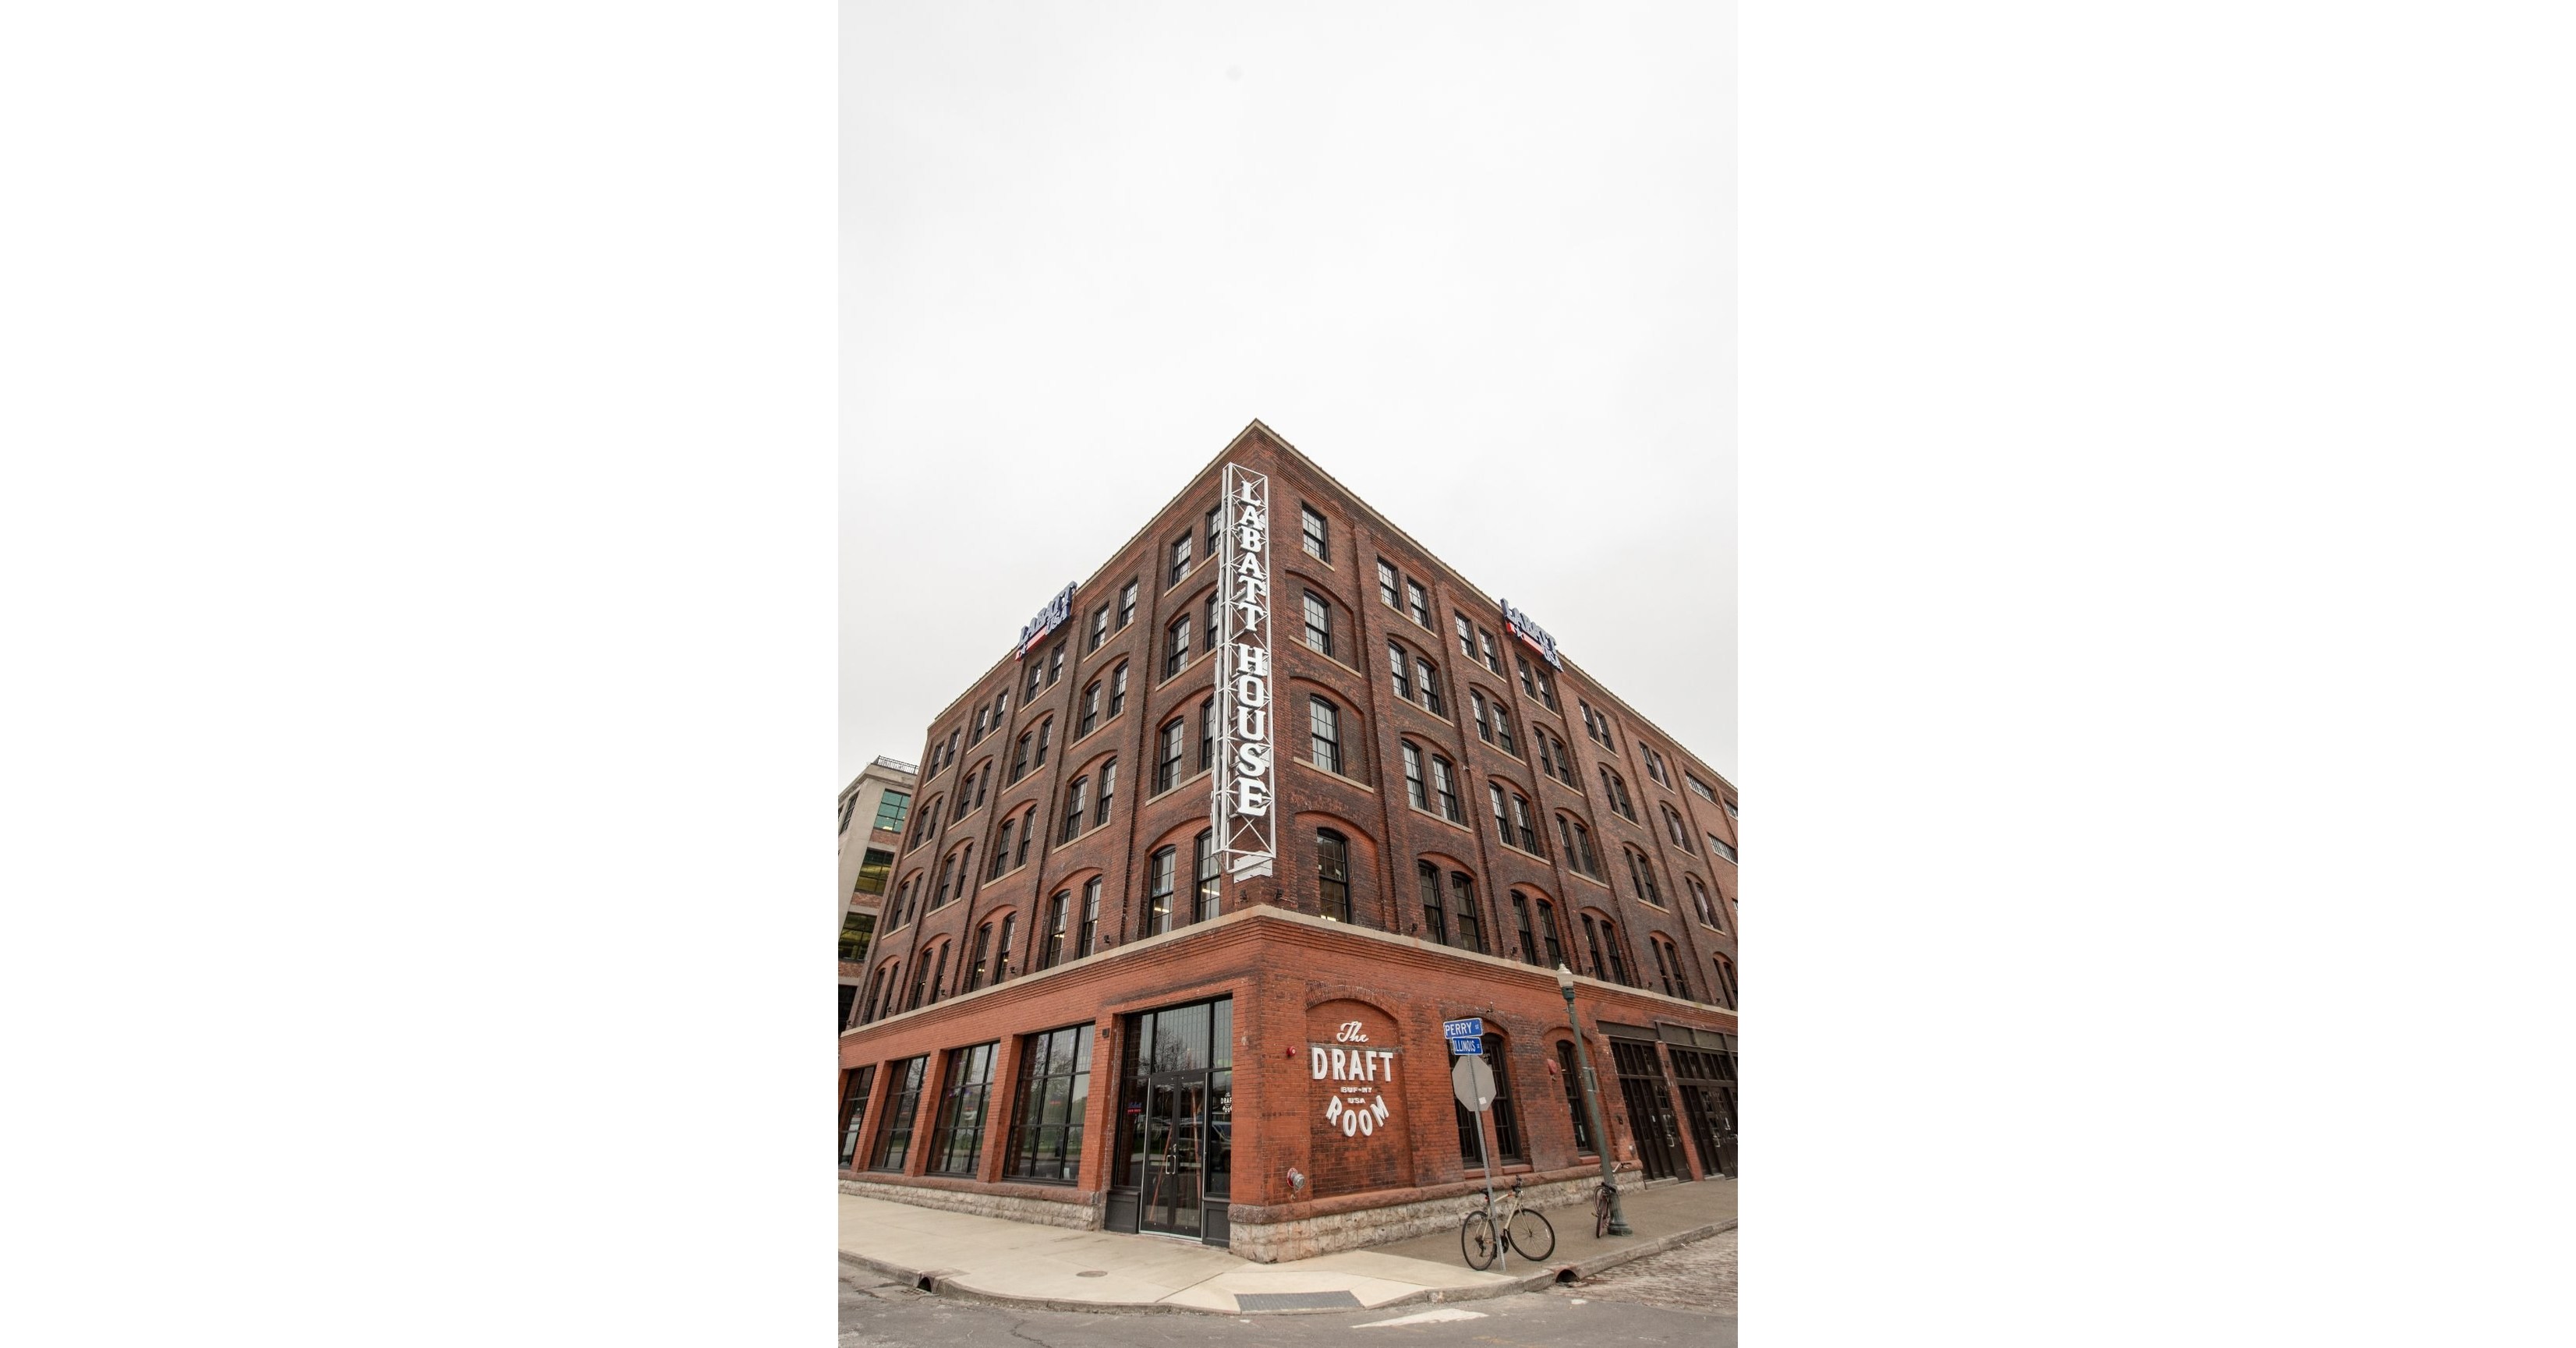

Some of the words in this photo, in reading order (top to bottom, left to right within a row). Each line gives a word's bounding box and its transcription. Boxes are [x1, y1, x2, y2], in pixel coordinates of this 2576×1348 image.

[1238, 480, 1265, 632] LABATT
[1237, 642, 1267, 816] HOUSE
[1336, 1021, 1369, 1042] The
[1445, 1022, 1472, 1036] PERRY
[1453, 1040, 1476, 1052] ILLINOIS
[1311, 1047, 1393, 1082] DRAFT
[1325, 1095, 1389, 1137] ROOM
